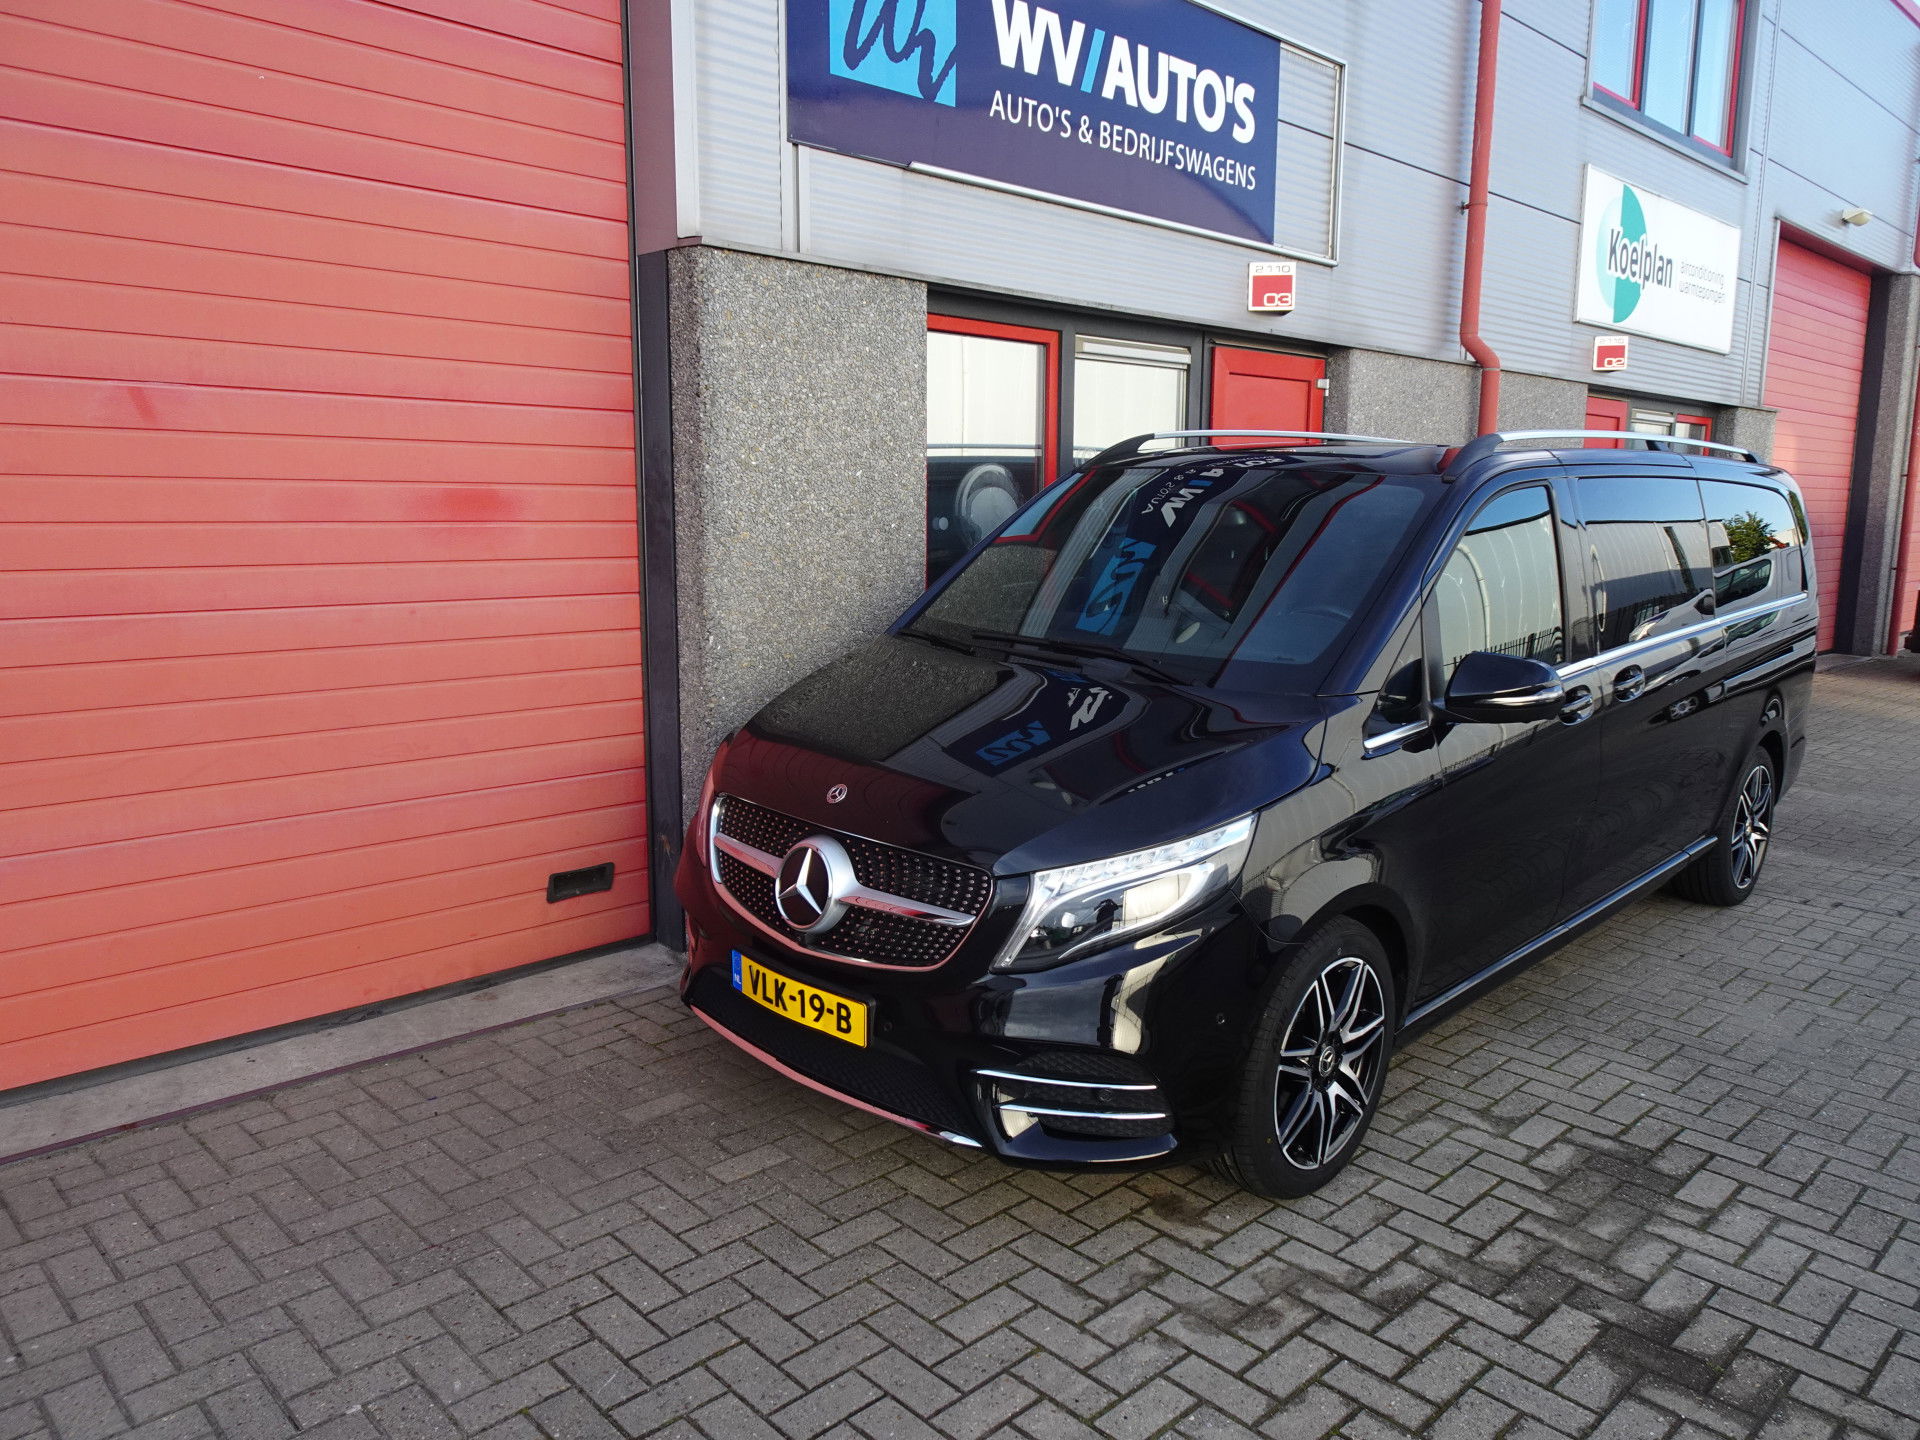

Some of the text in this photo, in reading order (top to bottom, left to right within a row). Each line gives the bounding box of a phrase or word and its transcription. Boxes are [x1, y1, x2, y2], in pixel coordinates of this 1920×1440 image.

[989, 90, 1256, 190] AUTO'S & BEDRIJFSWAGENS
[1255, 265, 1291, 273] 2110
[1608, 228, 1673, 289] Koelplan
[1263, 292, 1292, 307] 03
[1604, 357, 1625, 368] 02
[748, 965, 852, 1034] VLK-19-B
